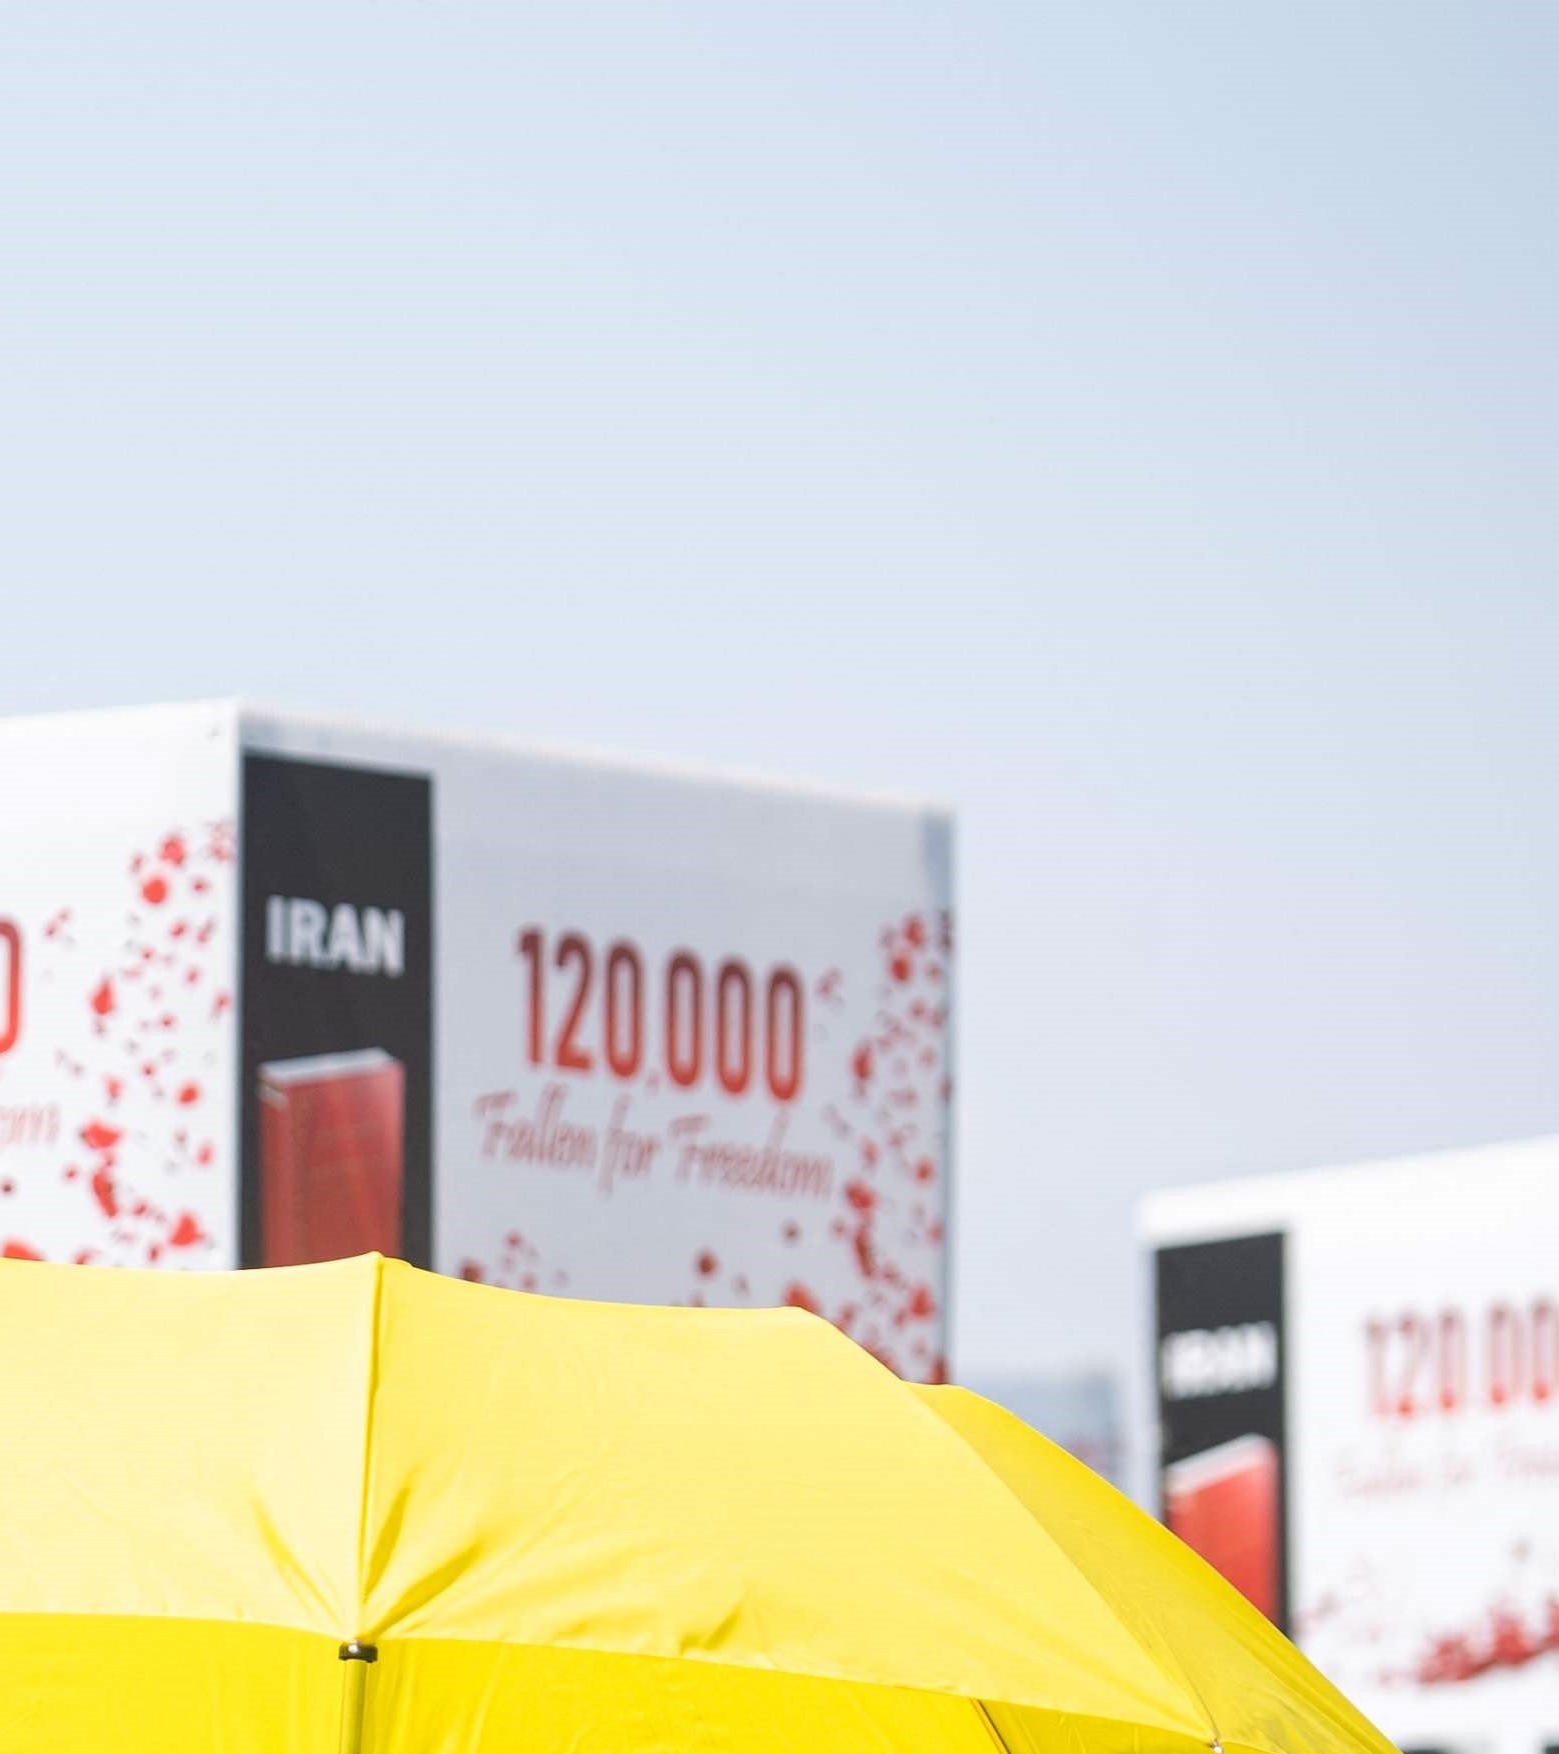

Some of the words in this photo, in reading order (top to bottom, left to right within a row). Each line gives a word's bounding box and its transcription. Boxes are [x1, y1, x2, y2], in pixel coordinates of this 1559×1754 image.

[265, 895, 405, 976] IRAN
[517, 926, 805, 1103] 120,000
[474, 1085, 597, 1168] Fallen
[666, 1109, 835, 1199] Freedom
